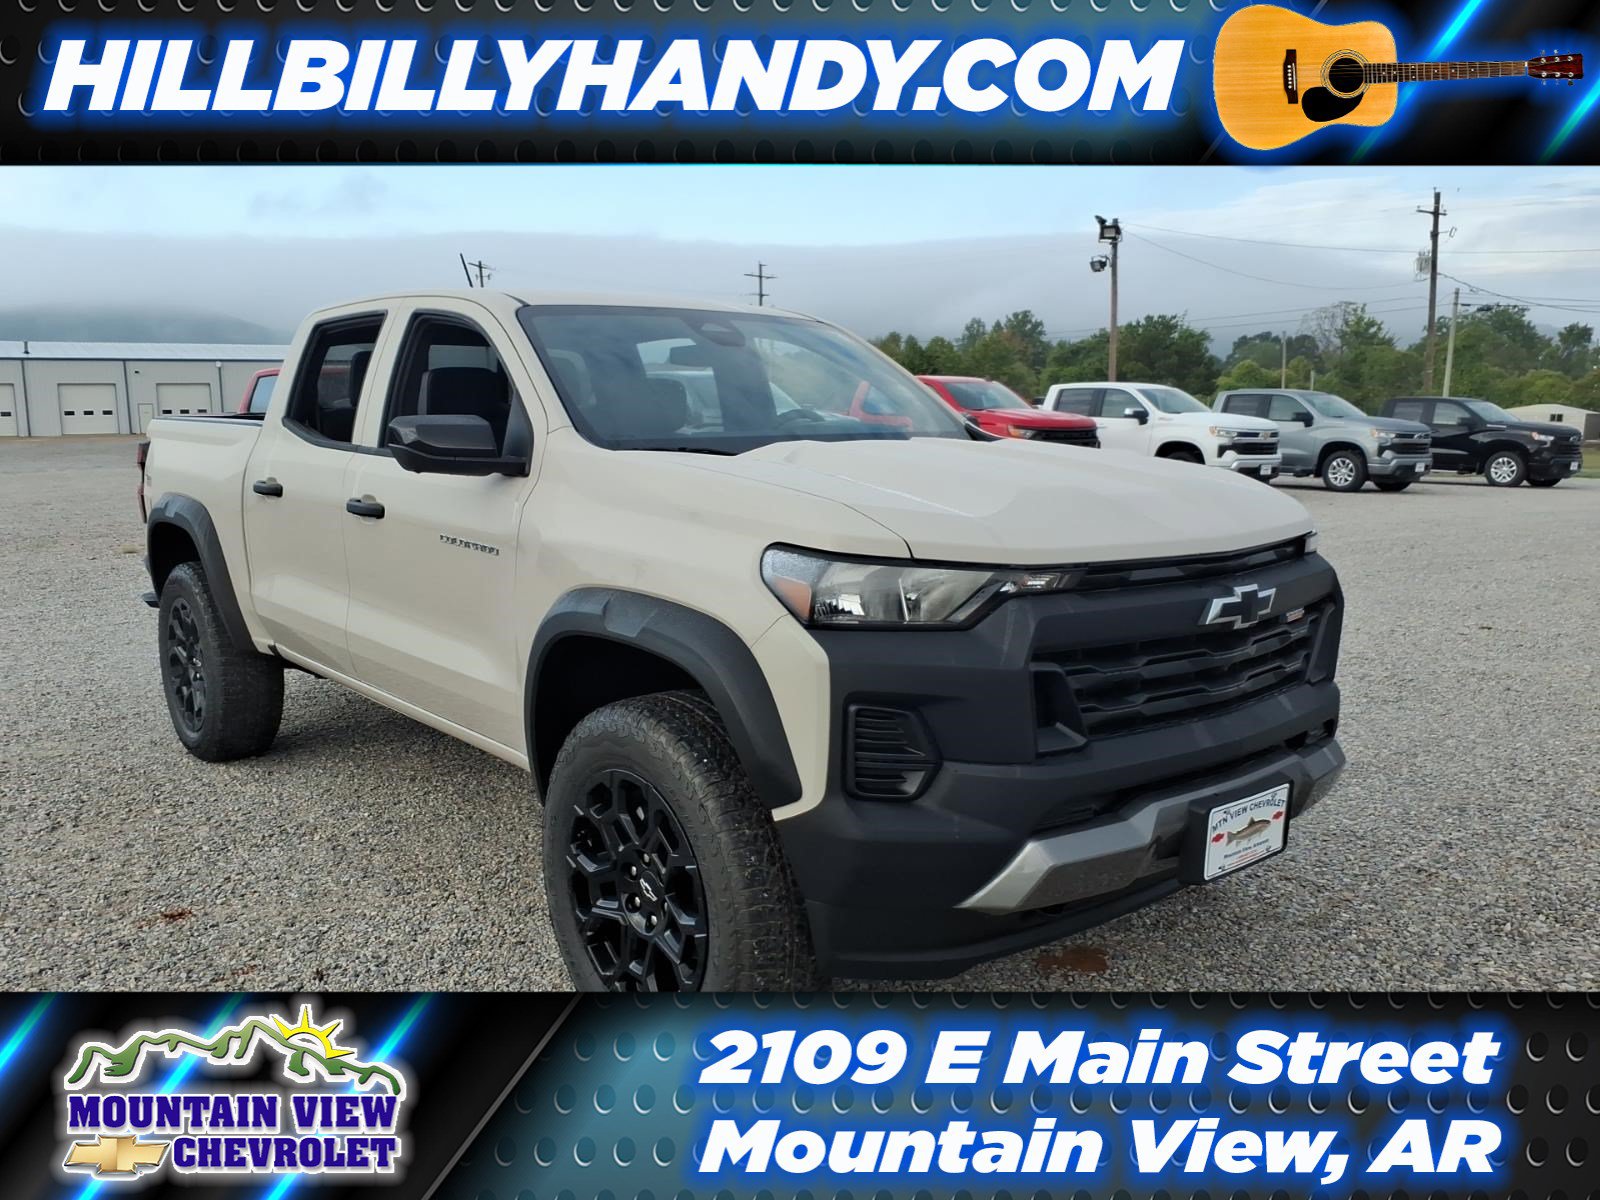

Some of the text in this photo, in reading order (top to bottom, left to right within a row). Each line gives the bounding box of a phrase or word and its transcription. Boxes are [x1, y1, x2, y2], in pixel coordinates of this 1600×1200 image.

[1212, 799, 1285, 832] MTN VIEW CHEVROLET
